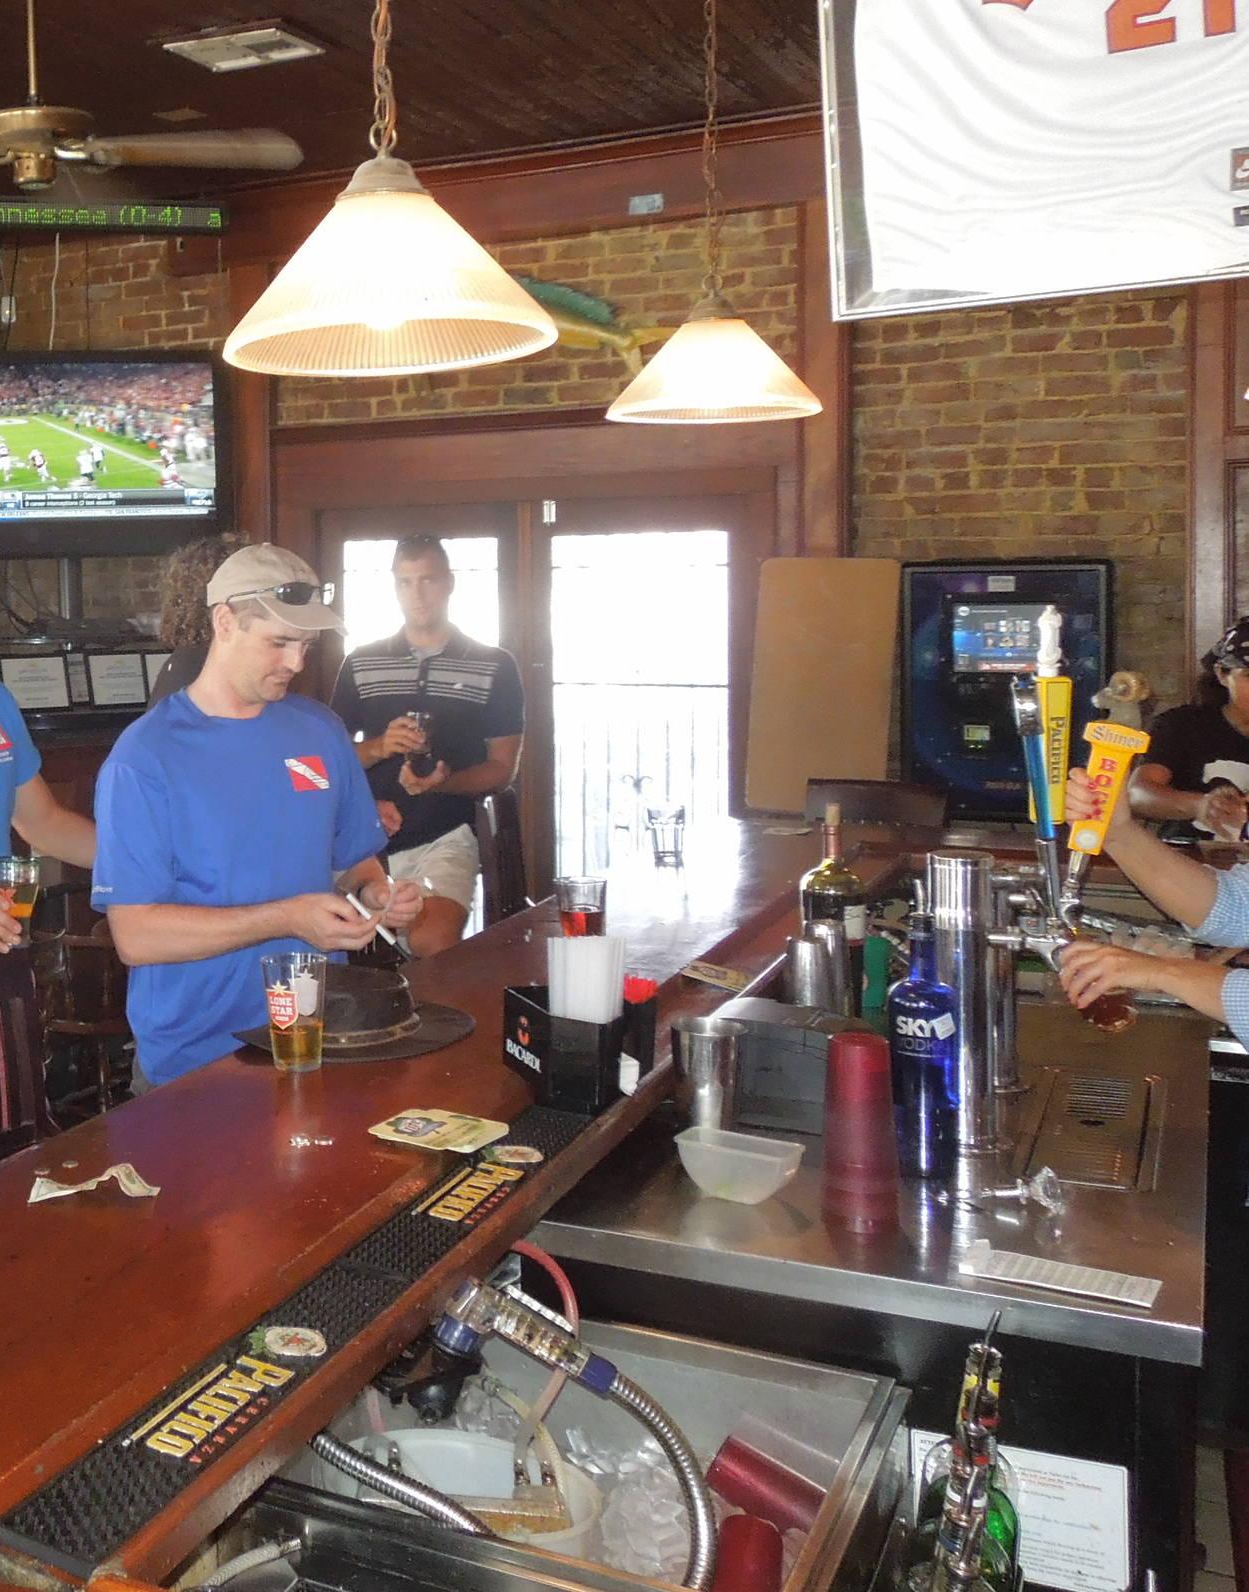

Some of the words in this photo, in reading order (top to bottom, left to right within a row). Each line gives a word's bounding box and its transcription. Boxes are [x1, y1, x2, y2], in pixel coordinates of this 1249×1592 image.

[1092, 724, 1145, 749] Shiner
[270, 996, 293, 1005] LONE
[270, 1005, 294, 1015] STAR
[146, 1355, 295, 1458] PACIFICO
